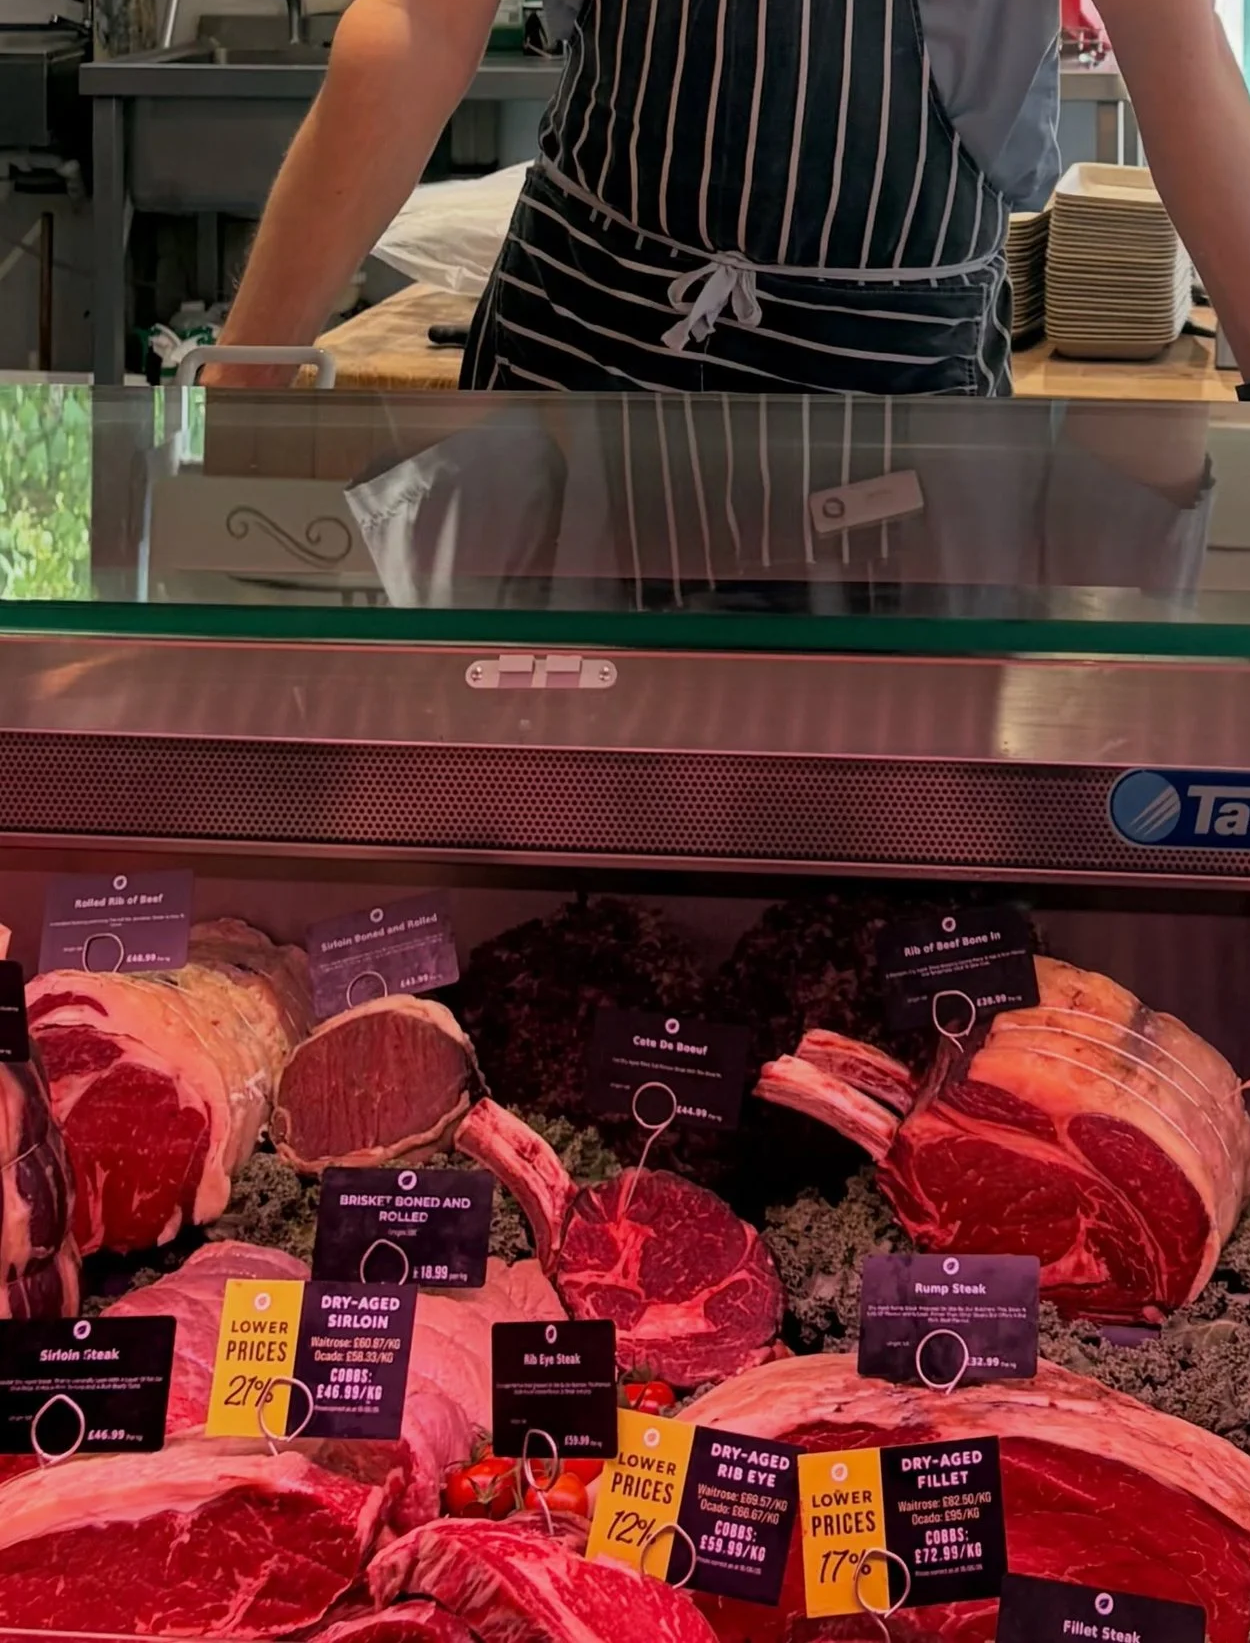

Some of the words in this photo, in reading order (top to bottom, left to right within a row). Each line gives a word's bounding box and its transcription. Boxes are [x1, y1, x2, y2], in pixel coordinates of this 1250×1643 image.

[74, 898, 106, 909] Rolled
[108, 896, 125, 906] Rib
[127, 894, 138, 905] of
[139, 893, 164, 904] Beef
[407, 913, 438, 929] Rolled
[904, 946, 921, 957] Rib
[923, 942, 934, 953] of
[936, 938, 960, 951] Beef
[962, 933, 988, 946] Bone
[990, 930, 1001, 941] In
[339, 1194, 393, 1207] BRISKET
[395, 1196, 440, 1208] BONED
[442, 1197, 471, 1209] AND
[379, 1211, 428, 1223] ROLLED
[915, 1283, 949, 1296] Rump
[952, 1283, 987, 1295] Steak
[321, 1295, 400, 1311] DRY-AGED
[231, 1320, 289, 1334] LOWER
[327, 1314, 389, 1329] SIRLOIN
[226, 1340, 288, 1362] PRICES
[311, 1336, 351, 1348] Waitrose:
[40, 1349, 80, 1362] Sirloin
[83, 1348, 120, 1360] Steak
[314, 1350, 344, 1362] Ocado:
[524, 1353, 538, 1365] Rib
[539, 1354, 554, 1367] Eye
[556, 1353, 581, 1365] Steak
[330, 1368, 373, 1383] COBBS:
[224, 1375, 274, 1407] 21%
[316, 1384, 382, 1401] £46.99/KG
[618, 1452, 677, 1476] LOWER
[711, 1443, 790, 1470] DRY-AGED
[901, 1450, 983, 1472] DRY-AGED
[717, 1464, 743, 1481] RIB
[747, 1470, 776, 1488] EYE
[917, 1471, 969, 1489] FILLET
[611, 1472, 675, 1505] PRICES
[698, 1483, 740, 1503] Waitrose:
[701, 1498, 730, 1515] Ocado:
[812, 1490, 873, 1508] LOWER
[898, 1498, 941, 1512] Waitrose:
[812, 1511, 876, 1537] PRICES
[912, 1512, 943, 1525] Ocado:
[944, 1507, 980, 1522] £95/KG
[607, 1510, 656, 1547] 12%
[714, 1520, 757, 1542] COBBS:
[925, 1527, 969, 1545] COBBS:
[700, 1534, 766, 1562] £59.99/KG
[914, 1542, 982, 1564] £72.99/KG
[1063, 1619, 1099, 1639] Fillet
[1102, 1627, 1141, 1643] Steak
